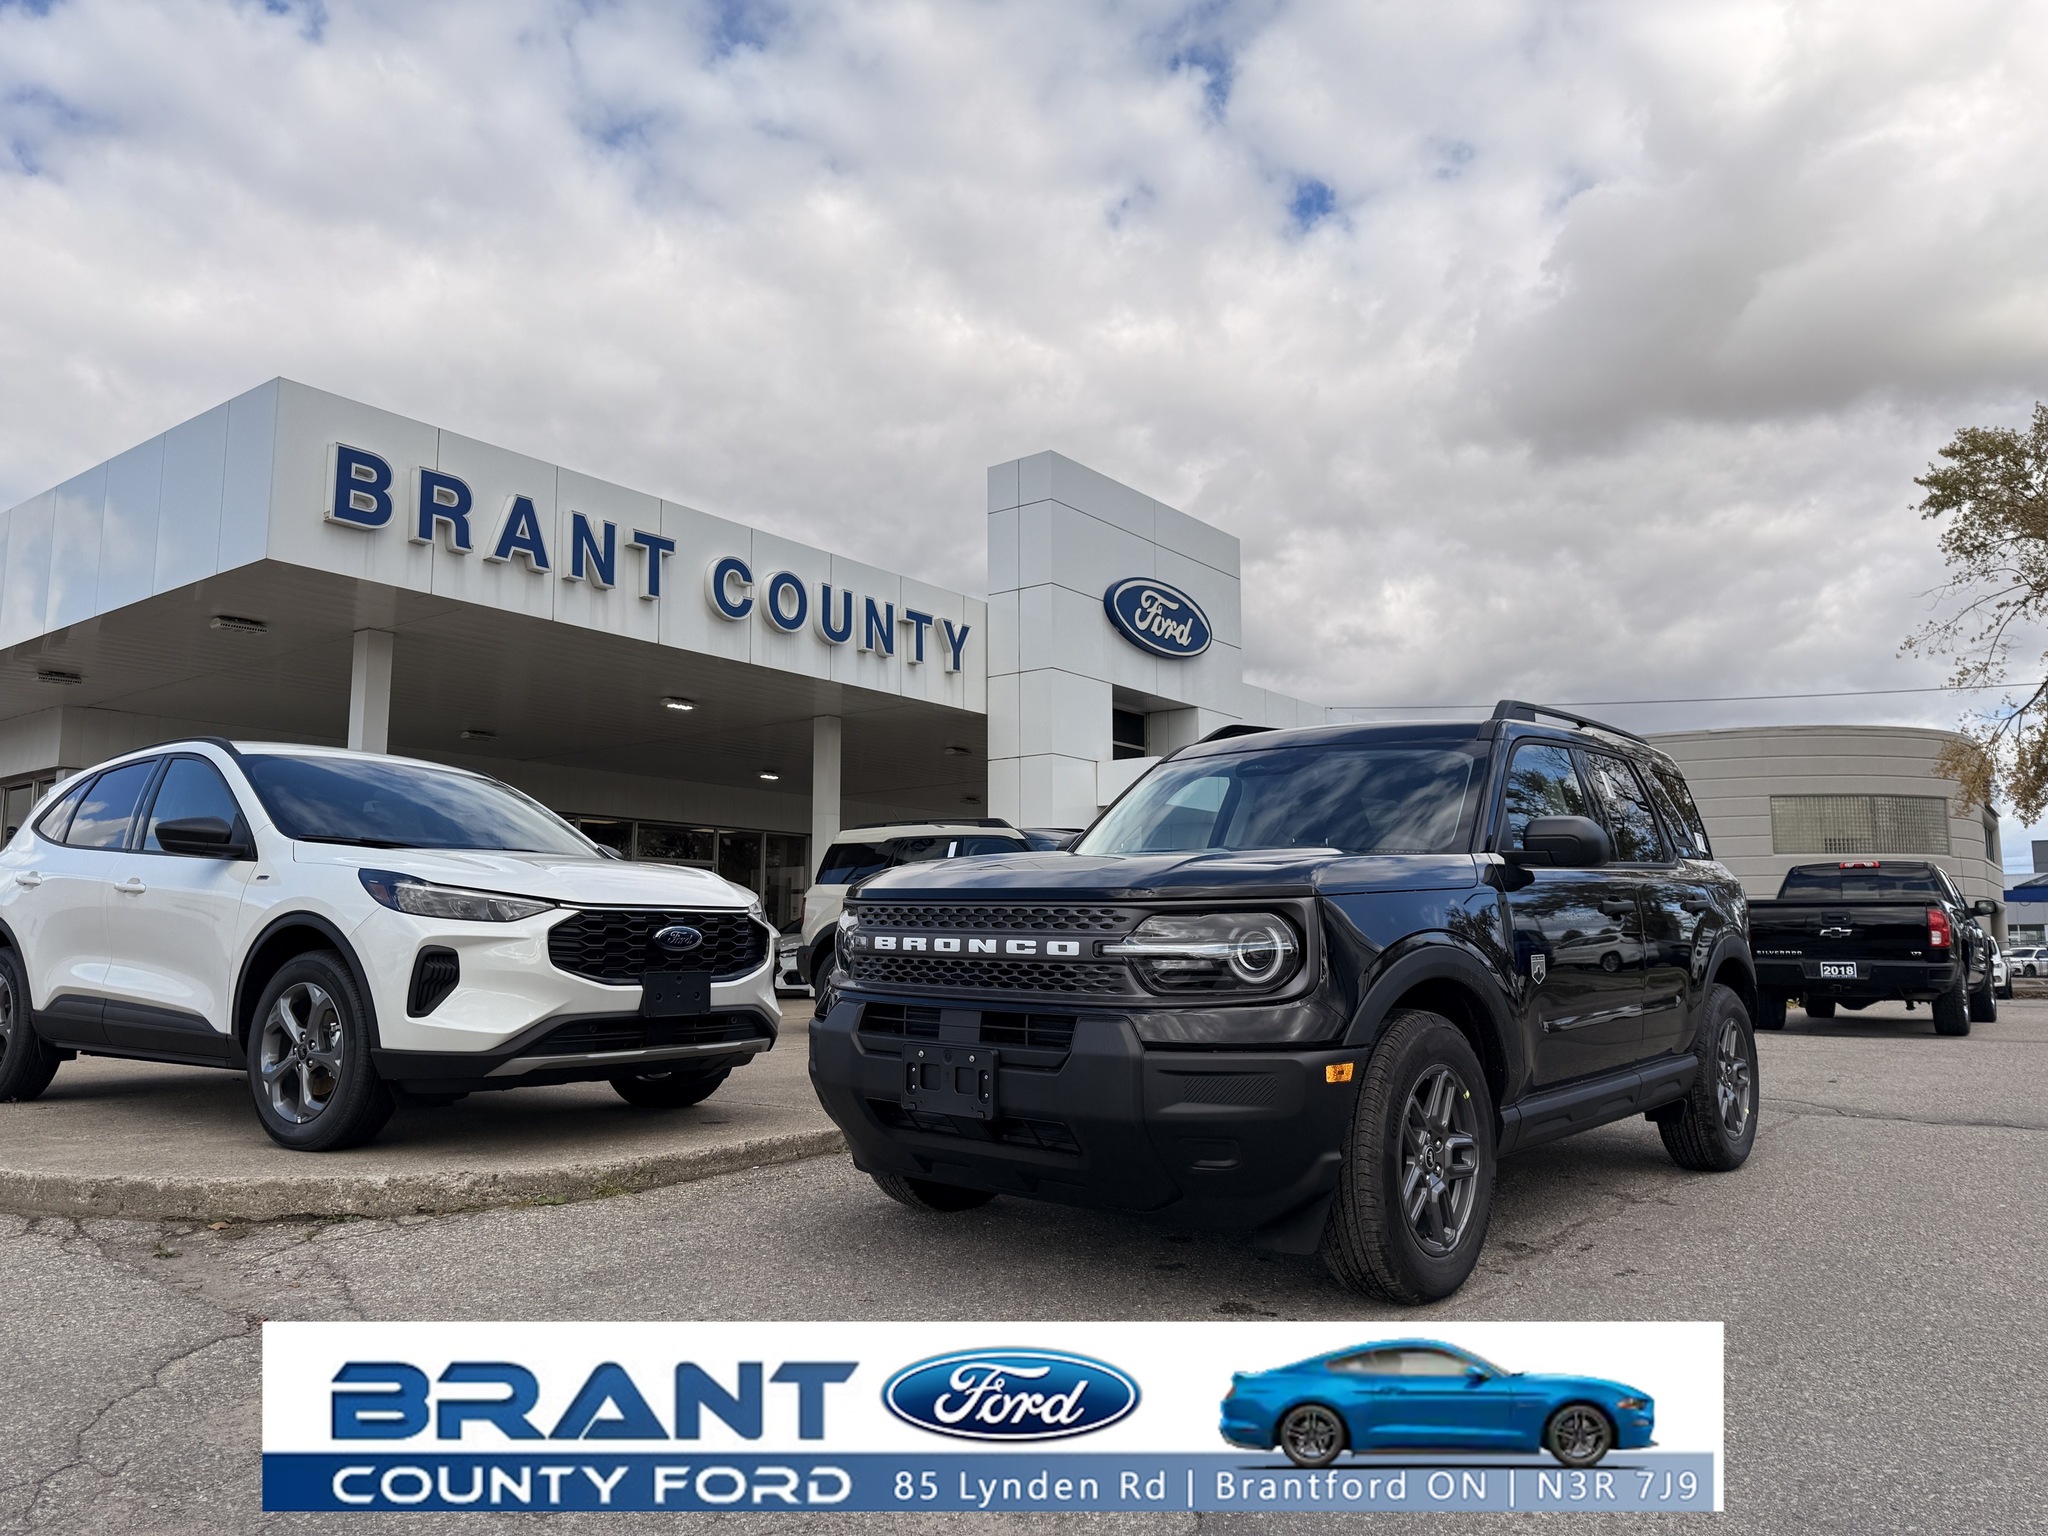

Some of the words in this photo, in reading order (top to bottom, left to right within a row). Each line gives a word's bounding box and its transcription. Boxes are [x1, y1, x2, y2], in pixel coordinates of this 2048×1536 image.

[323, 441, 676, 601] BRANT
[704, 555, 971, 674] COUNTY
[1134, 589, 1194, 647] Ford
[667, 930, 694, 945] Ford
[874, 936, 1080, 956] BRONCO
[1823, 966, 1854, 975] 2018
